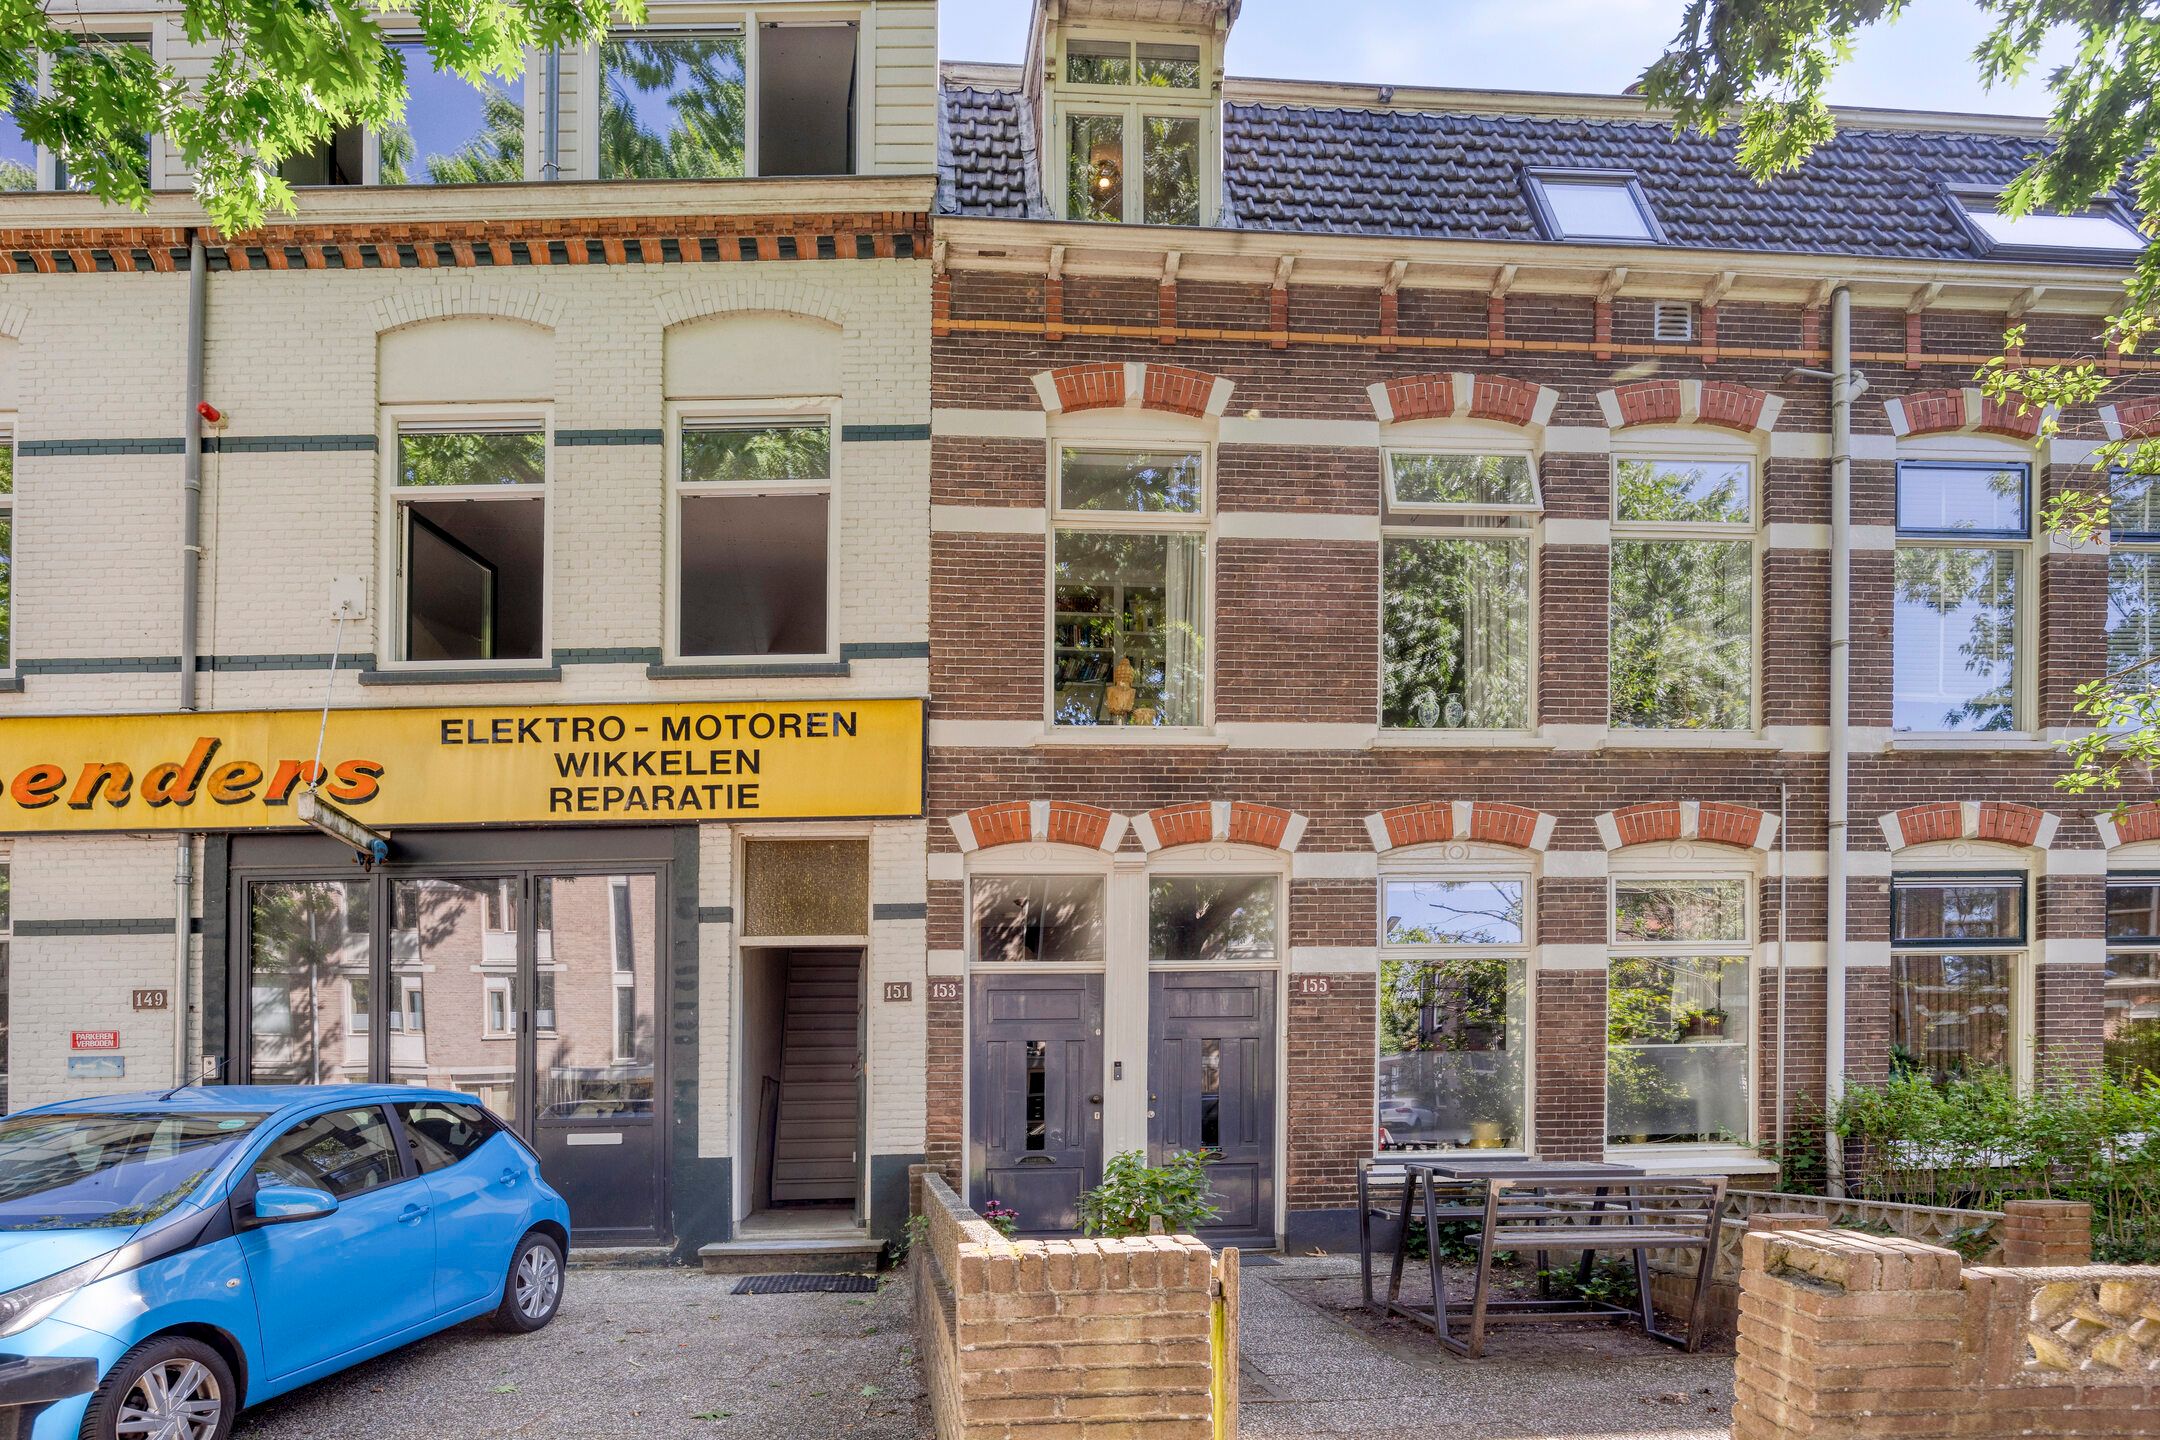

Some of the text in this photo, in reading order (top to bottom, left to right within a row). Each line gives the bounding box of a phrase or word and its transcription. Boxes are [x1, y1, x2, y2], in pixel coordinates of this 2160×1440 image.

[441, 716, 626, 745] ELEKTRO
[661, 711, 857, 741] MOTOREN
[554, 749, 760, 778] WIKKELEN
[0, 736, 385, 810] enders
[550, 783, 759, 813] REPARATIE
[886, 984, 909, 999] 151
[933, 983, 957, 998] 153
[1302, 978, 1328, 993] 155
[136, 992, 164, 1007] 149
[76, 1040, 114, 1048] VERBODEN
